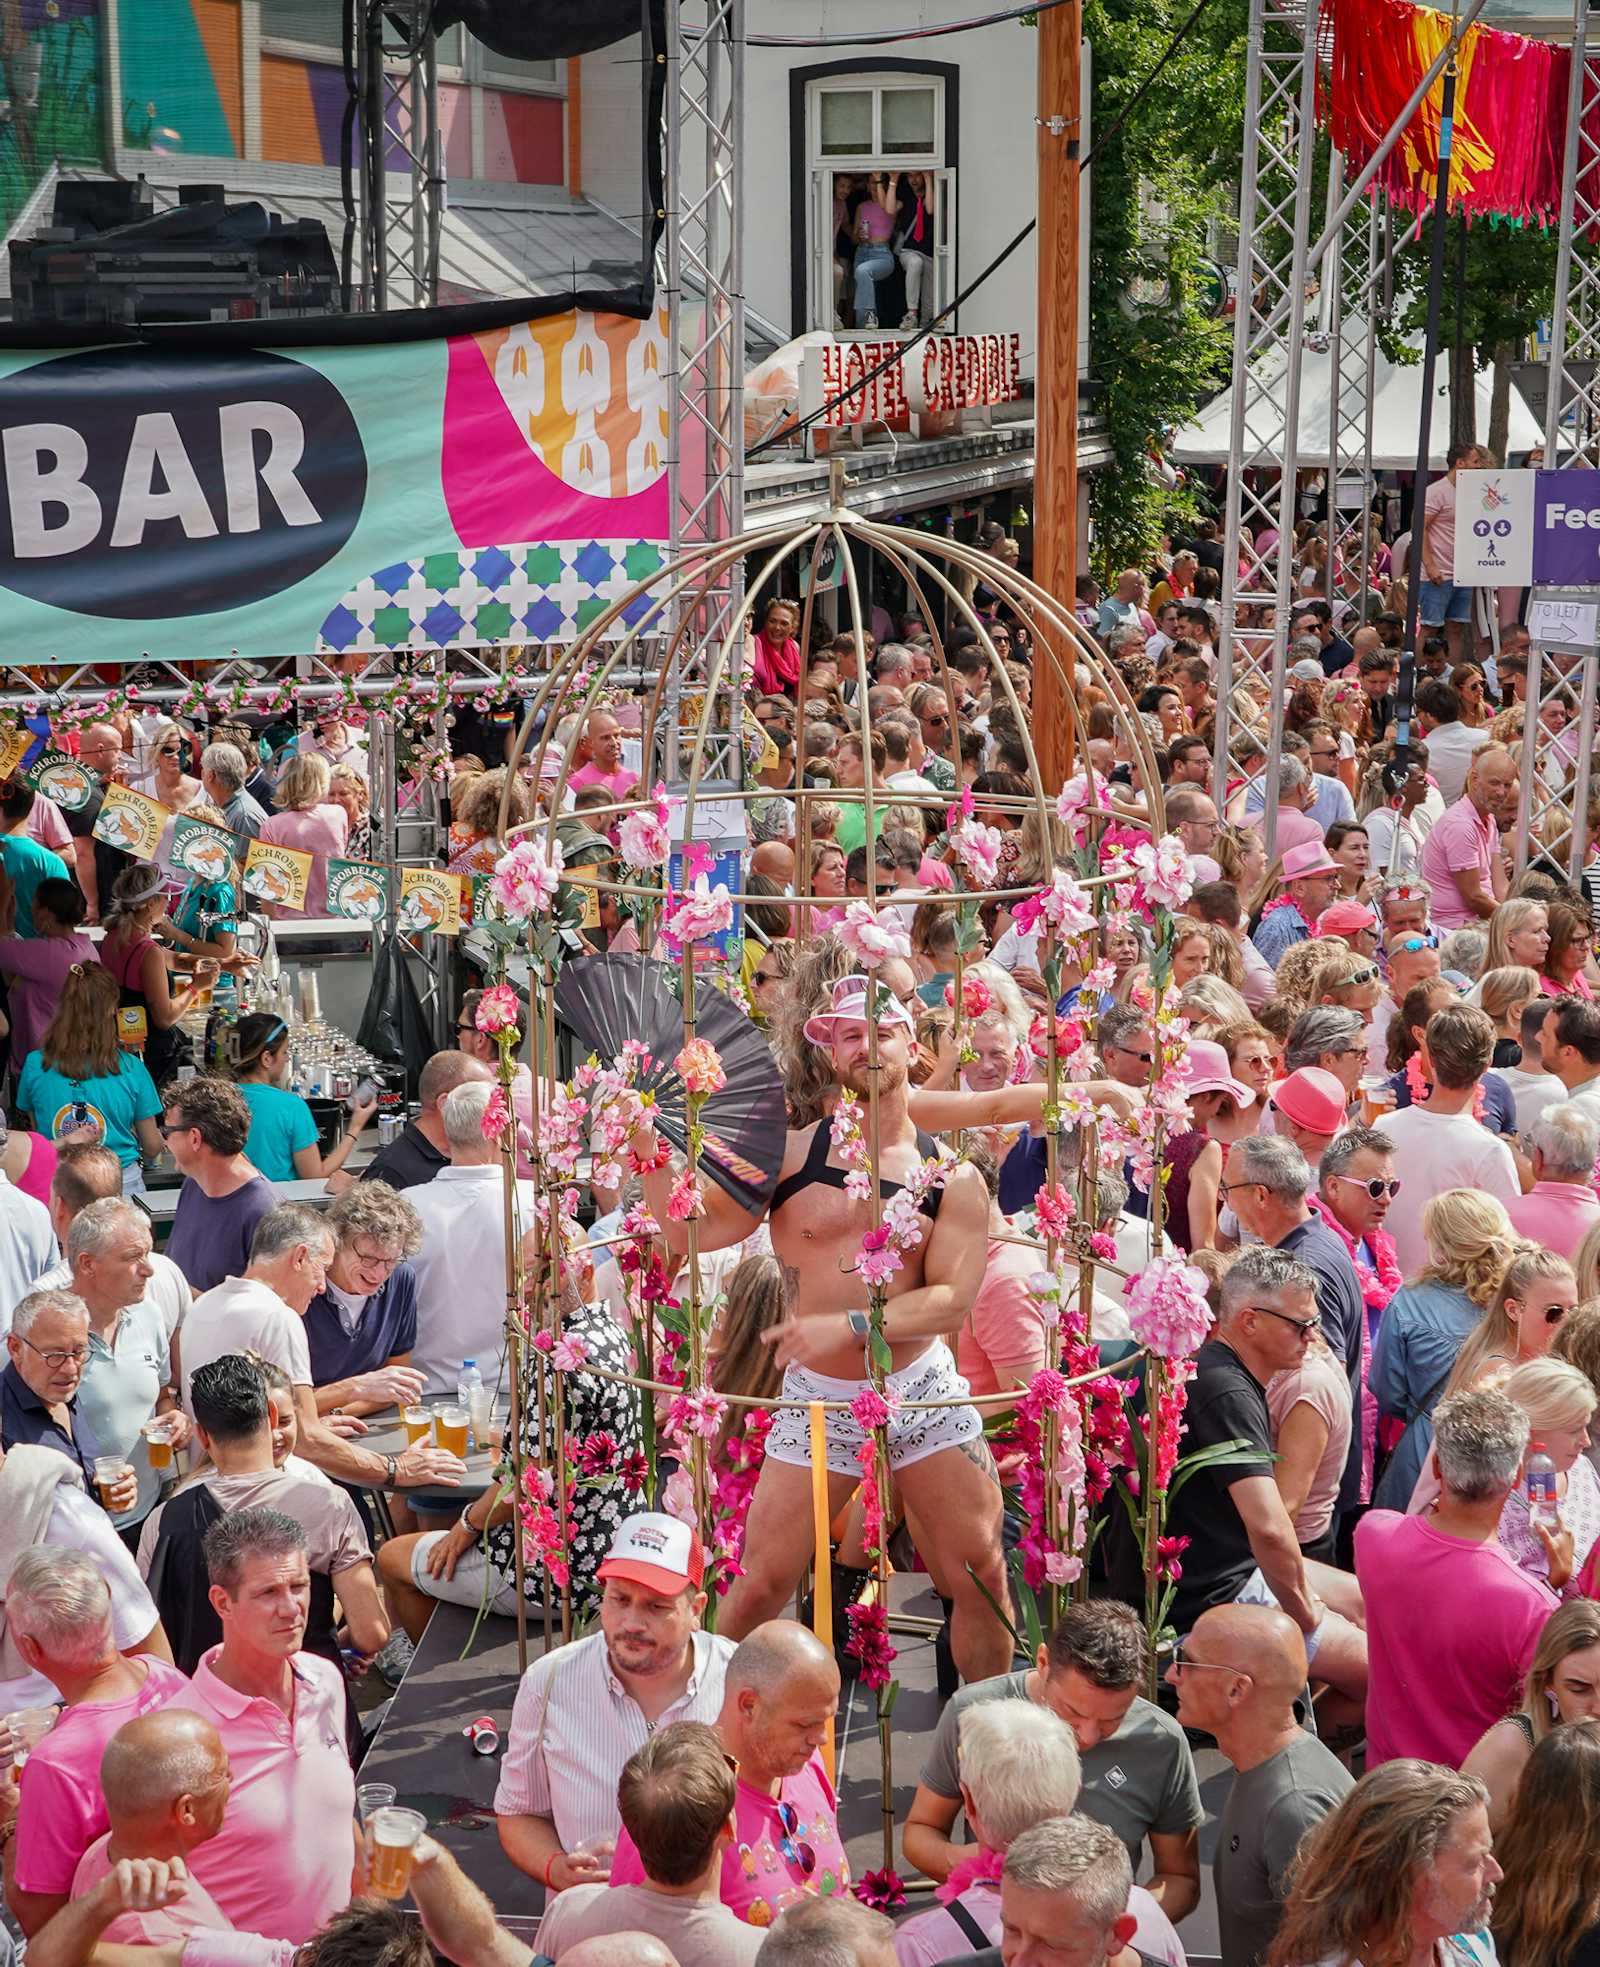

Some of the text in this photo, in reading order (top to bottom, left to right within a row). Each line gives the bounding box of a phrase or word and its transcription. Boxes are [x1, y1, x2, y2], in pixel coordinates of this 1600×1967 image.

[823, 333, 1021, 426] HOTEL CREDIBLE
[2, 400, 323, 559] BAR
[1478, 559, 1506, 567] route
[1536, 603, 1583, 618] TOILET
